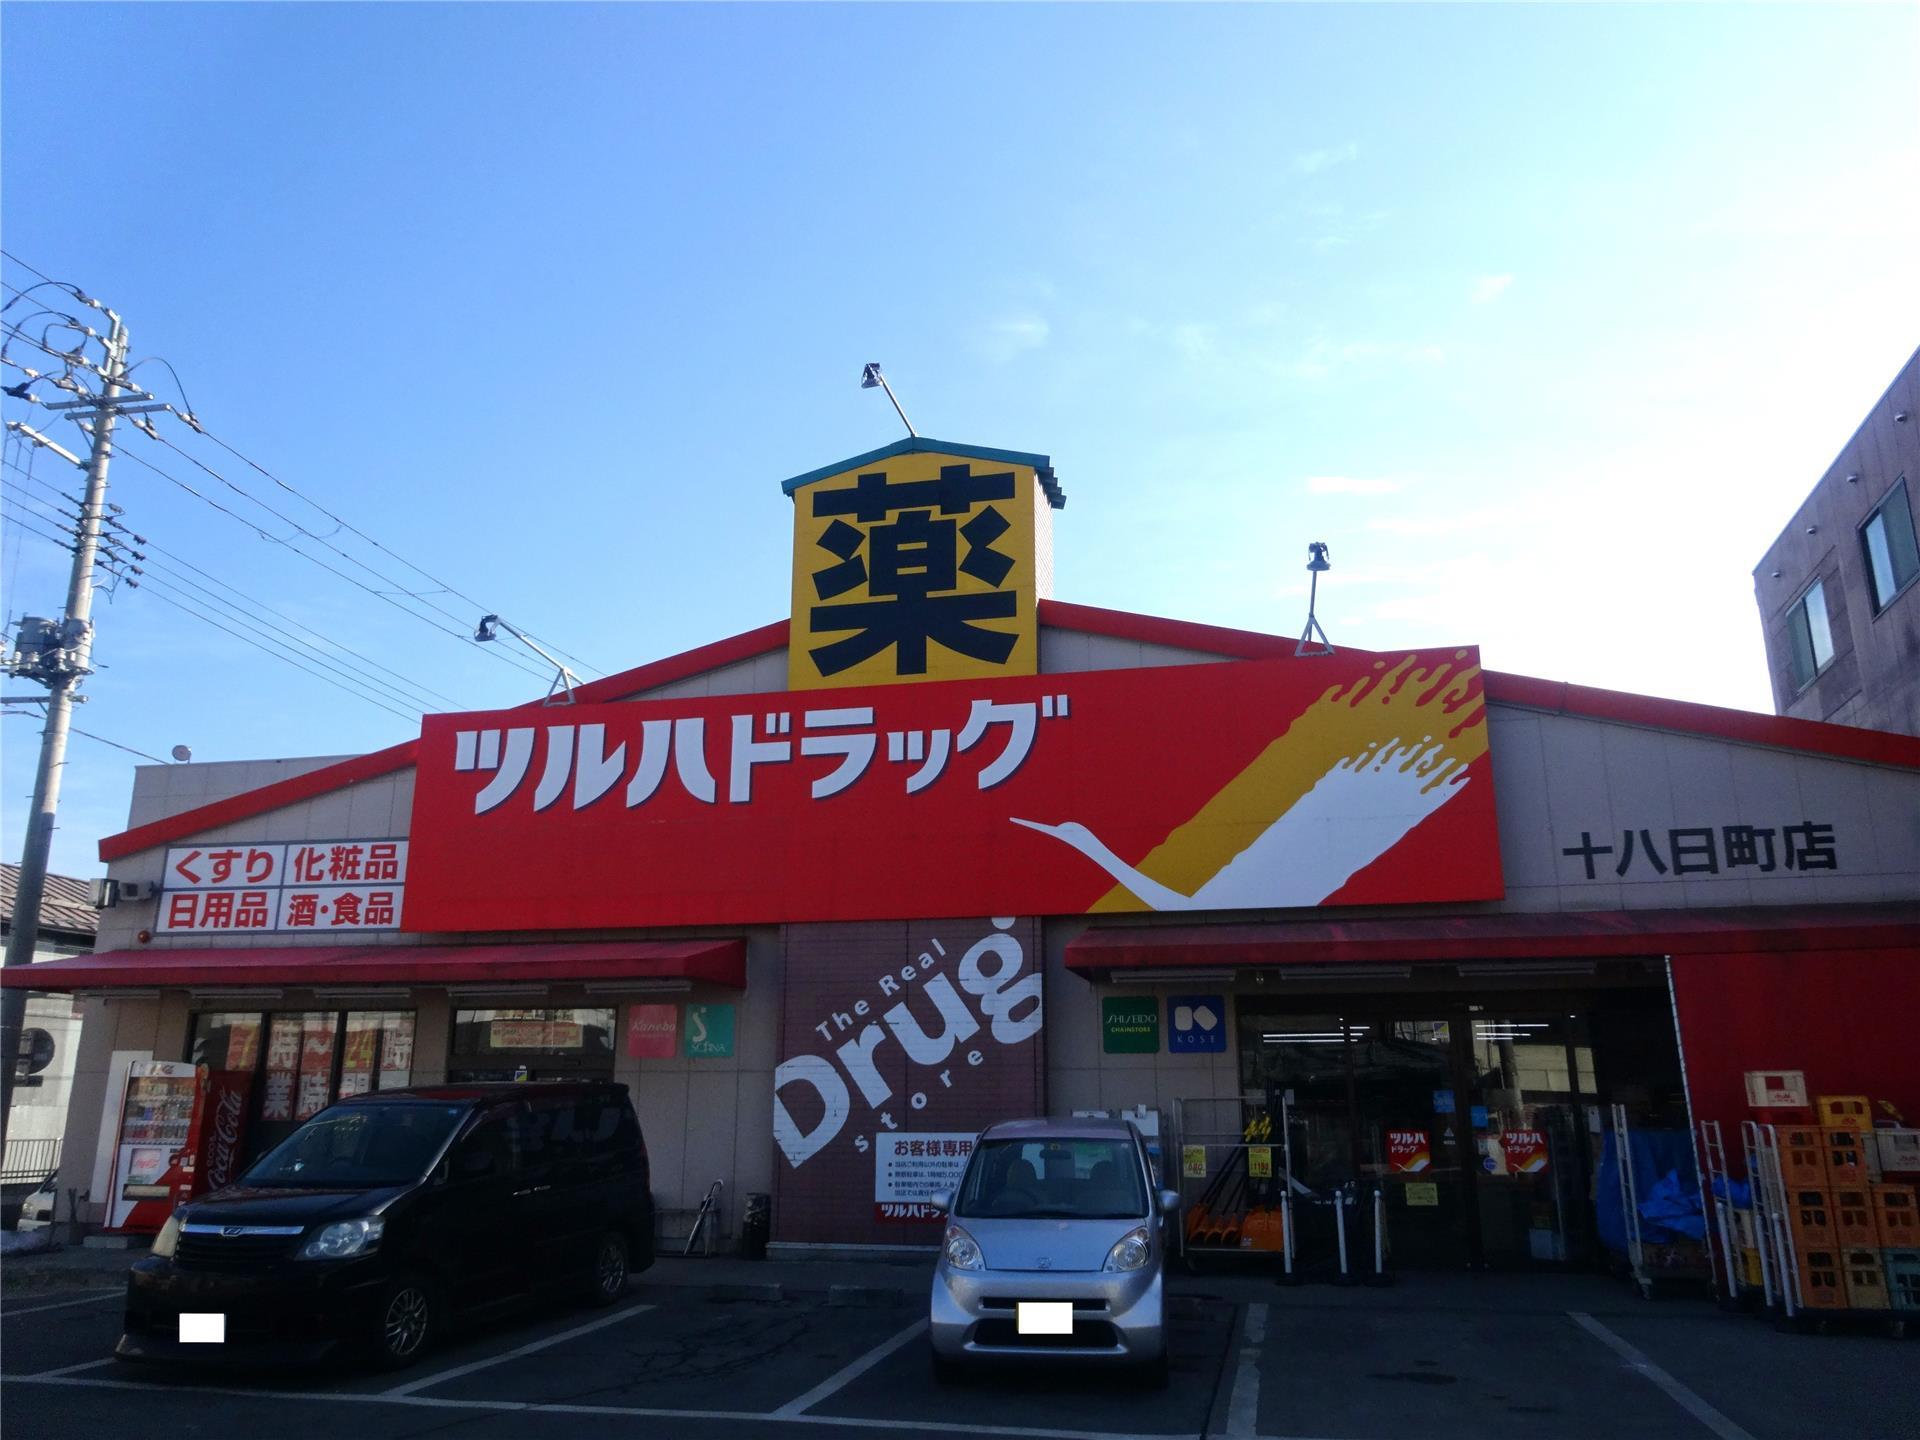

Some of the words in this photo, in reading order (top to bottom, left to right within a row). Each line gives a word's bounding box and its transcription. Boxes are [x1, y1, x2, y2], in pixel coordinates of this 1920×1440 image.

[808, 464, 1019, 677] 薬
[454, 694, 1069, 815] ツルハドラッグ
[175, 849, 274, 884] くすり
[294, 844, 398, 882] 化粧品
[1562, 821, 1837, 880] 十八日町店
[168, 892, 268, 928] 日用品
[286, 892, 394, 926] 酒・食品
[815, 1000, 870, 1042] The
[878, 938, 946, 997] Real
[1106, 1014, 1157, 1025] SHISEIDO
[773, 930, 1042, 1169] Drug
[1389, 1132, 1427, 1145] ツルハ
[1505, 1132, 1545, 1145] ツルハ
